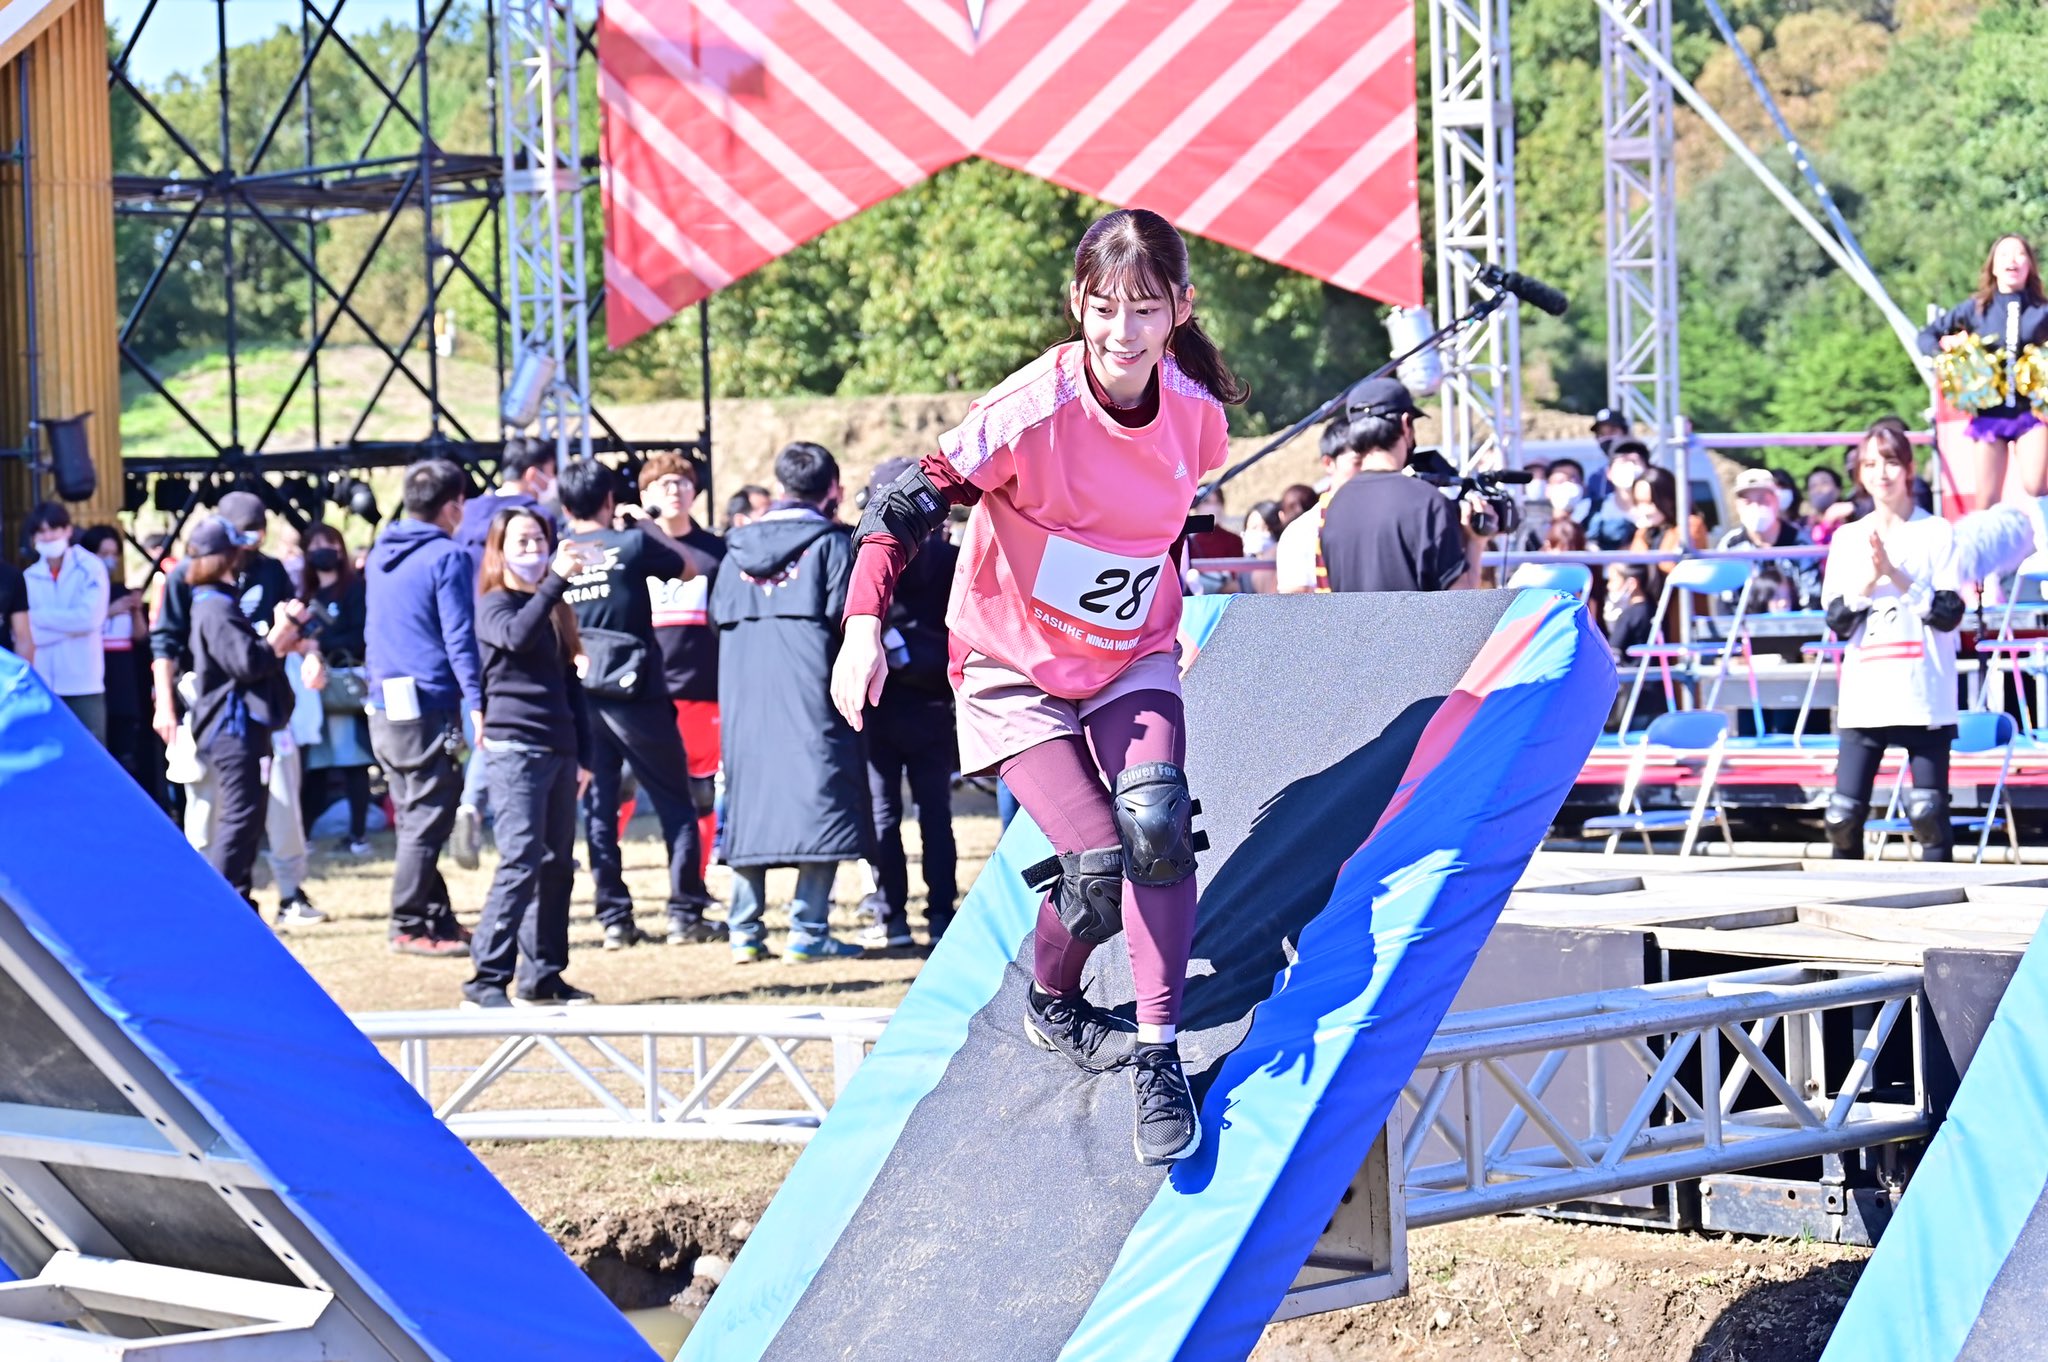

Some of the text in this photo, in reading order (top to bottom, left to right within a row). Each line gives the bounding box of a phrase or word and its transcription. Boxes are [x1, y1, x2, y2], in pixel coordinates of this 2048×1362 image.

[562, 584, 611, 605] STAFF
[1079, 565, 1160, 620] 28
[1033, 606, 1085, 640] SASUKE
[1085, 633, 1114, 650] NINJA
[1121, 764, 1177, 785] Silver Fox
